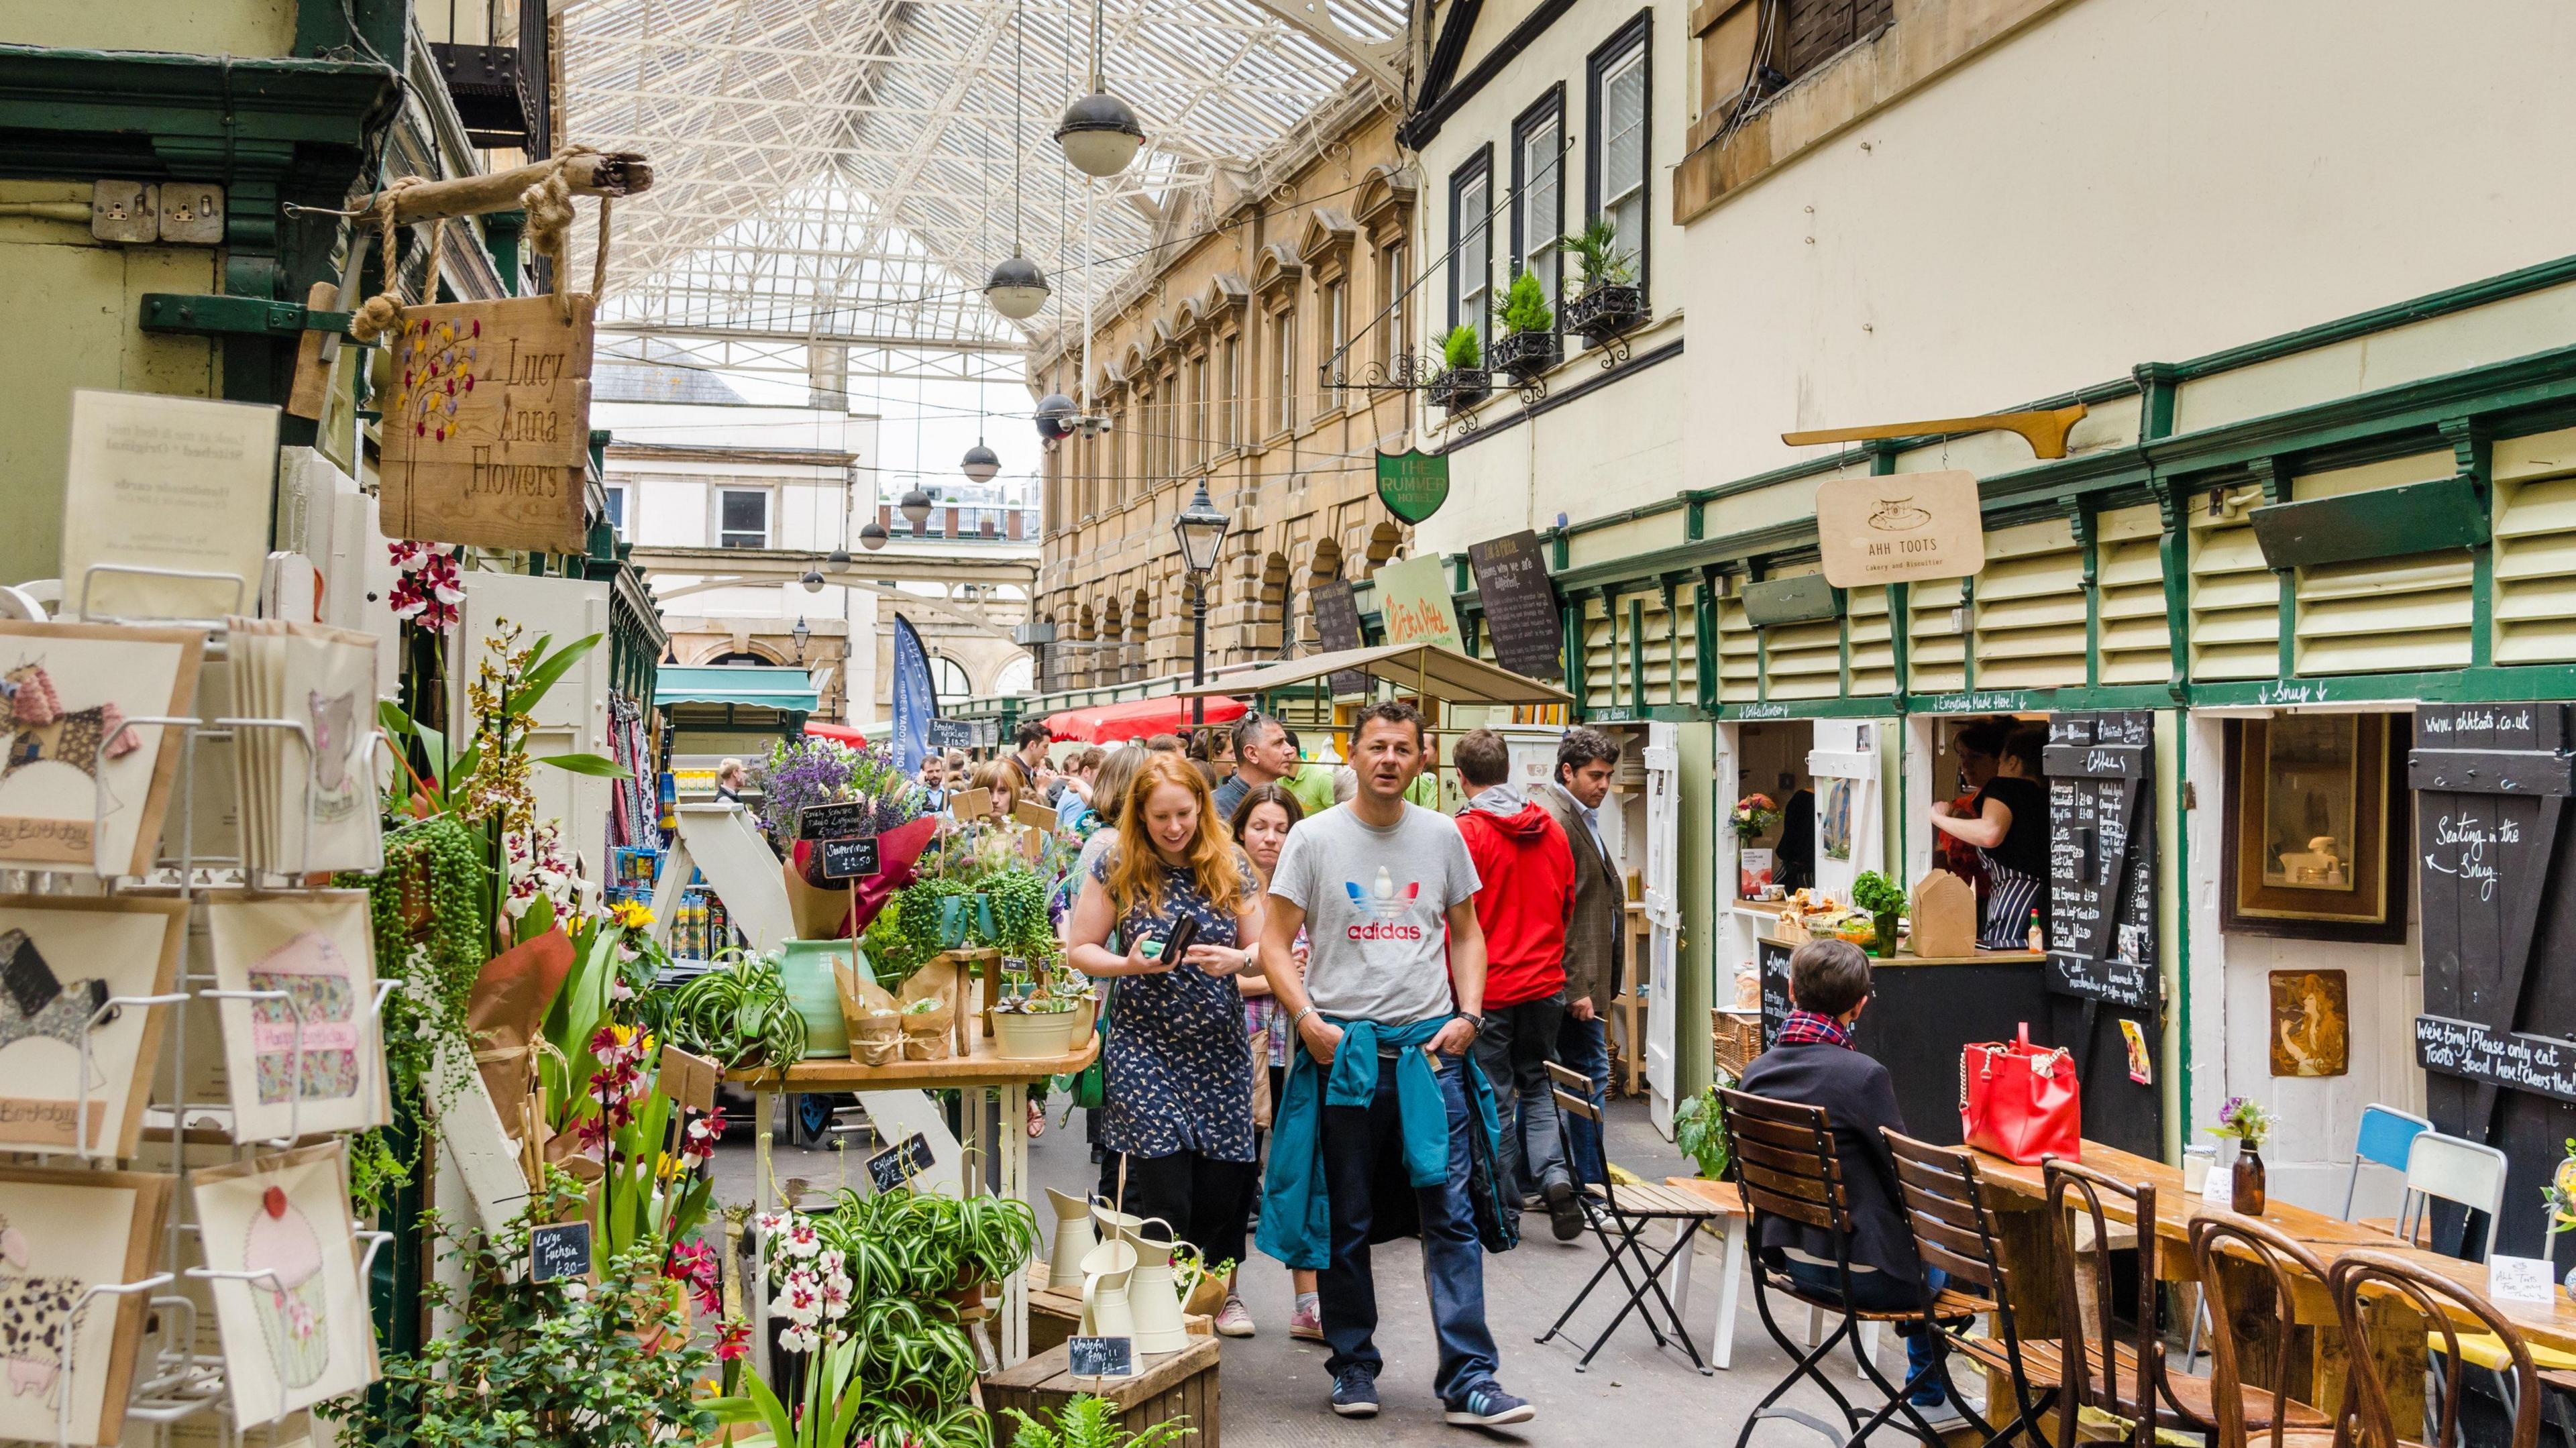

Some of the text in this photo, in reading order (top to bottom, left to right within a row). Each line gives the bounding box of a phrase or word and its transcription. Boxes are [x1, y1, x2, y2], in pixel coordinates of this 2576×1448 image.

[505, 338, 565, 402] Lucy
[498, 404, 558, 443] Anna
[471, 445, 557, 498] Flowers
[1401, 460, 1430, 476] THE
[1382, 477, 1446, 492] RUMMER
[1398, 493, 1432, 503] HOTEL
[1869, 539, 1937, 556] AHH TOOTS
[1509, 561, 1519, 572] we
[1521, 557, 1533, 571] are
[1866, 564, 1888, 572] Cakery
[1907, 559, 1943, 568] Biscuitier
[2272, 680, 2310, 703] Snug
[1939, 691, 2014, 712] Everything Made Here!
[934, 721, 956, 732] Beaded
[2051, 826, 2071, 841] Latte
[2436, 812, 2519, 861] Seating in the
[843, 856, 871, 871] £2.50
[2051, 854, 2063, 867] Hot
[2051, 867, 2063, 879] Flat
[2135, 895, 2149, 909] take
[2051, 905, 2066, 917] Loose
[2139, 912, 2148, 922] me
[1347, 922, 1421, 940] adidas
[2444, 1023, 2471, 1057] tiny!
[2471, 1029, 2506, 1056] Please
[2508, 1038, 2531, 1068] only
[2534, 1045, 2559, 1067] eat
[2424, 1042, 2576, 1095] Toots food here! Cheers then!
[536, 1233, 561, 1247] Large
[545, 1243, 578, 1266] Fuchsia
[1071, 1337, 1108, 1353] Wonderful
